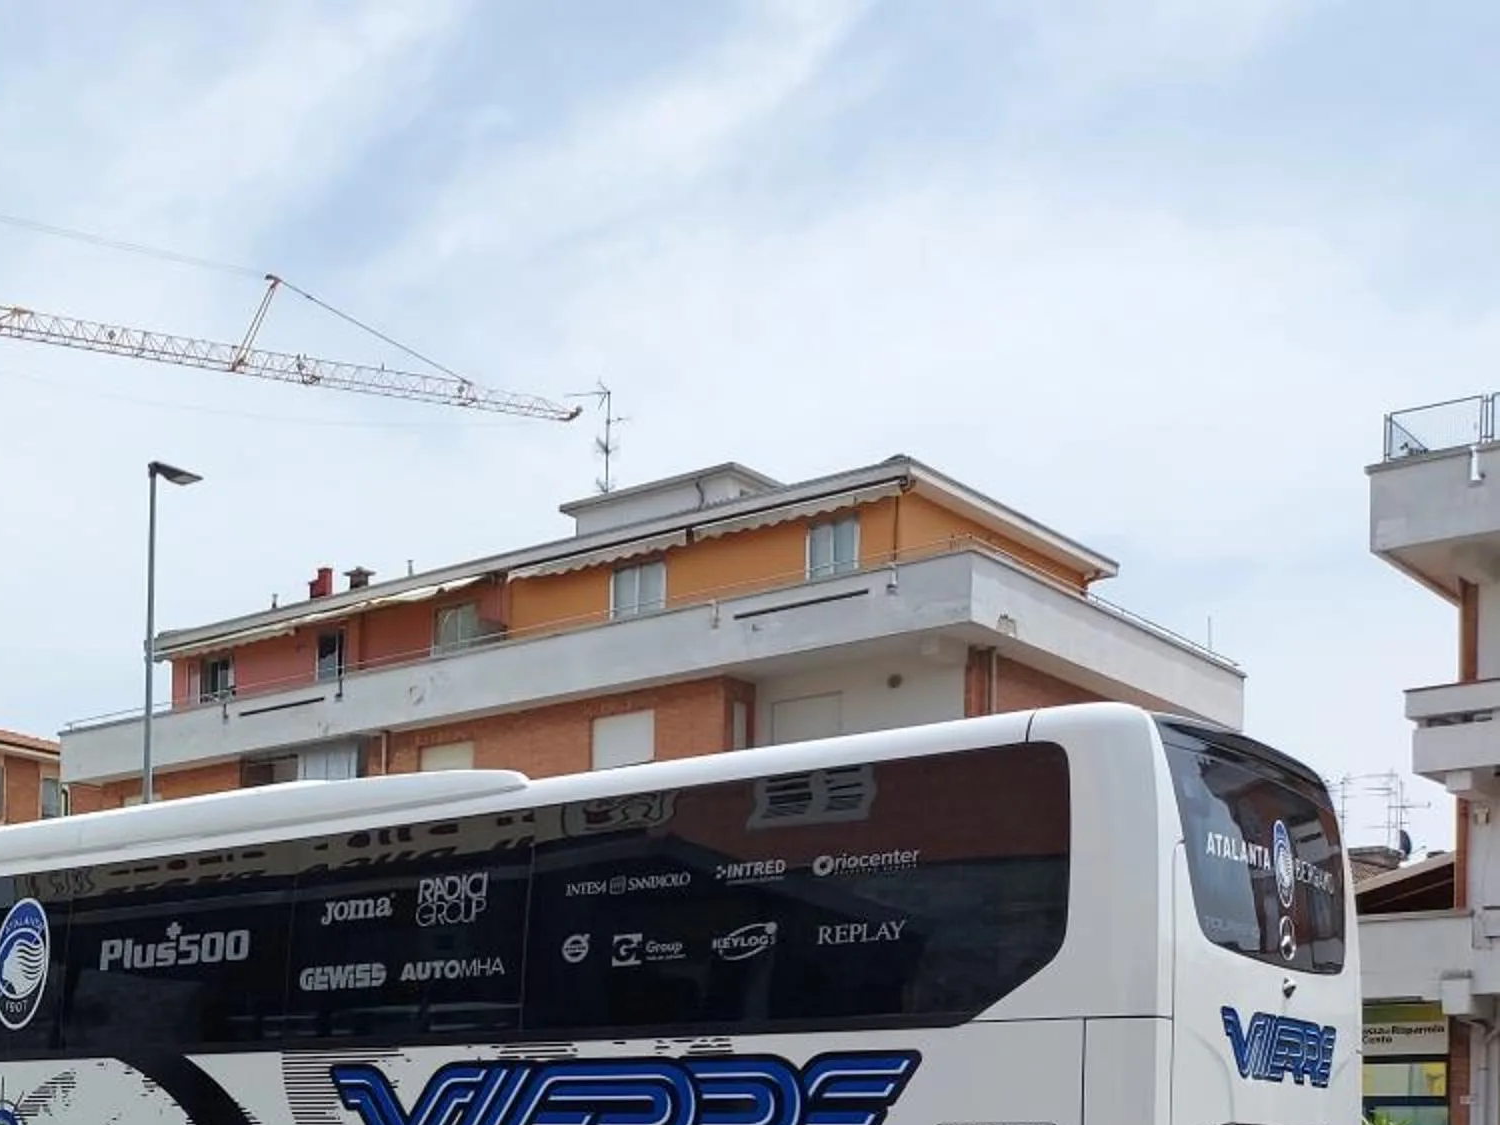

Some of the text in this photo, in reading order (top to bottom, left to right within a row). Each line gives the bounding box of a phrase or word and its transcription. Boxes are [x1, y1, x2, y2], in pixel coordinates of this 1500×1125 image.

[1206, 832, 1271, 871] ATALANTA
[727, 859, 787, 879] INTRED
[417, 871, 489, 904] RADICI
[565, 880, 607, 897] INTESA
[415, 897, 488, 927] GROUP
[817, 919, 907, 945] REPLAY
[100, 930, 250, 970] Plus500
[645, 941, 684, 955] Group
[300, 963, 387, 991] GEWISS
[400, 957, 505, 982] AUTOMHA
